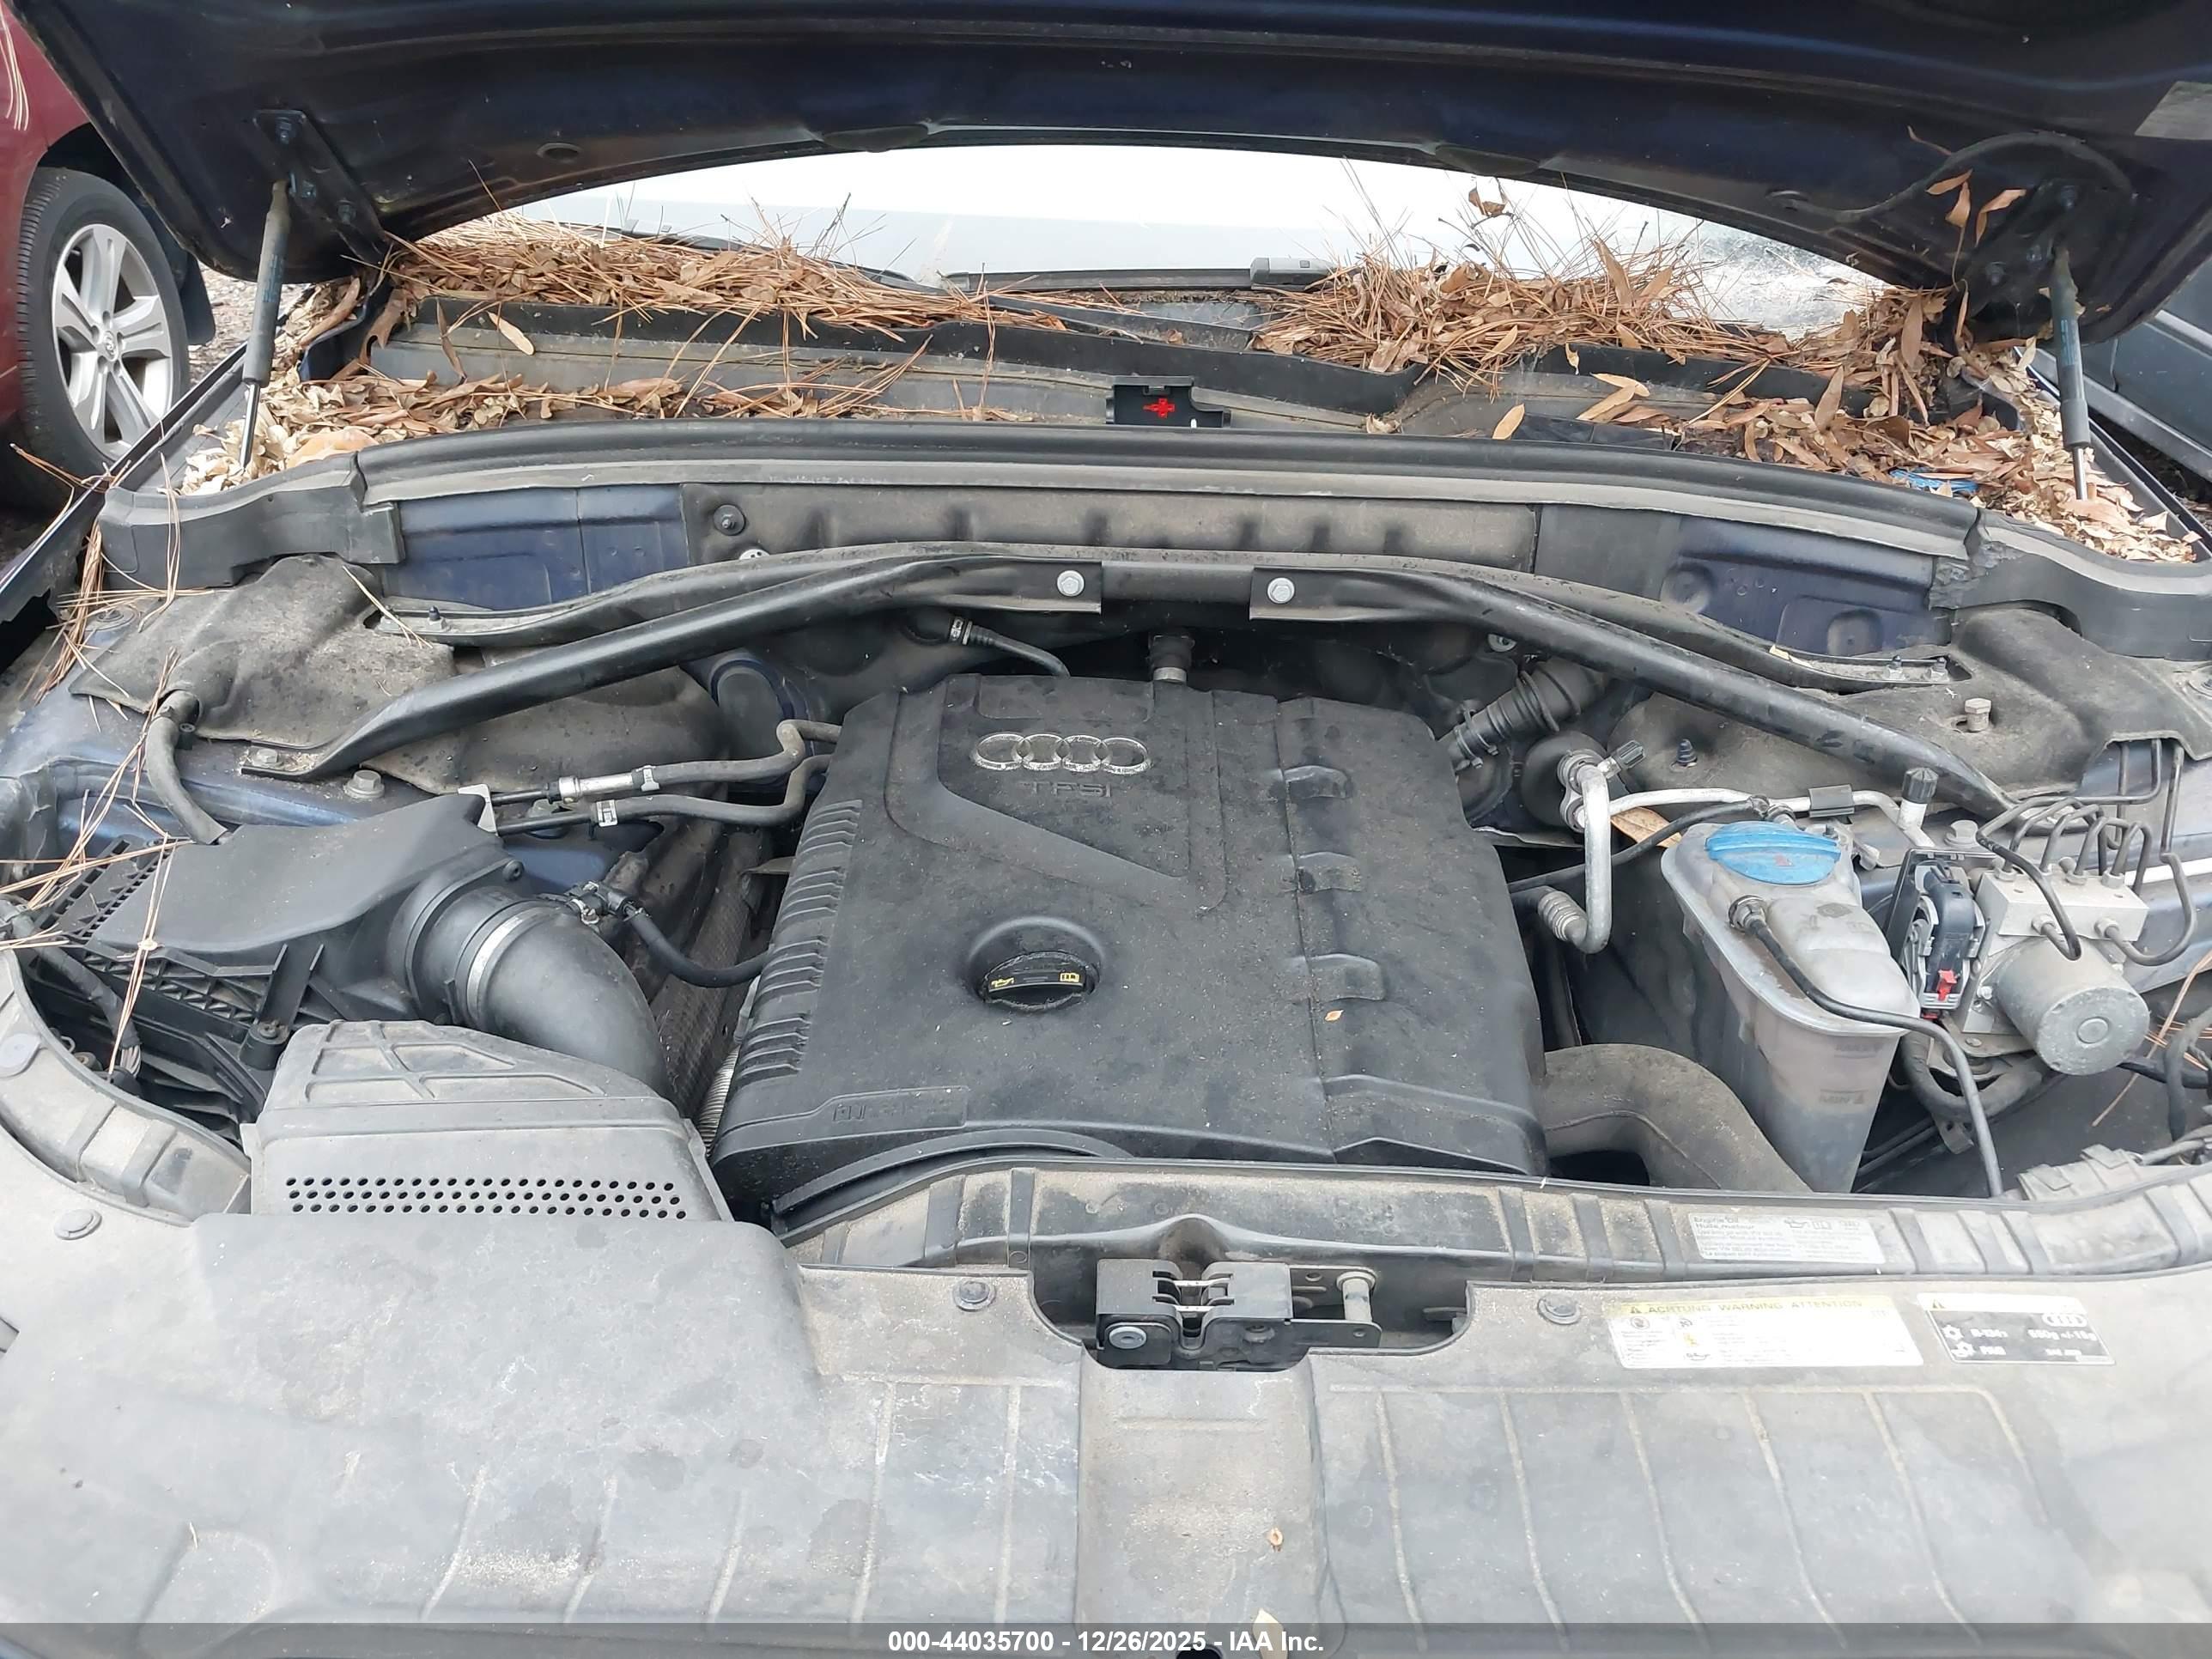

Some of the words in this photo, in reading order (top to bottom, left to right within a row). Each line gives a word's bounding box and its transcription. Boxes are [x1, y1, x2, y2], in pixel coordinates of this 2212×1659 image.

[1018, 780, 1113, 798] TFSI
[1648, 1304, 1711, 1314] ACHTUNG
[1718, 1302, 1784, 1311] WARNING
[1791, 1300, 1863, 1310] ATTENTION
